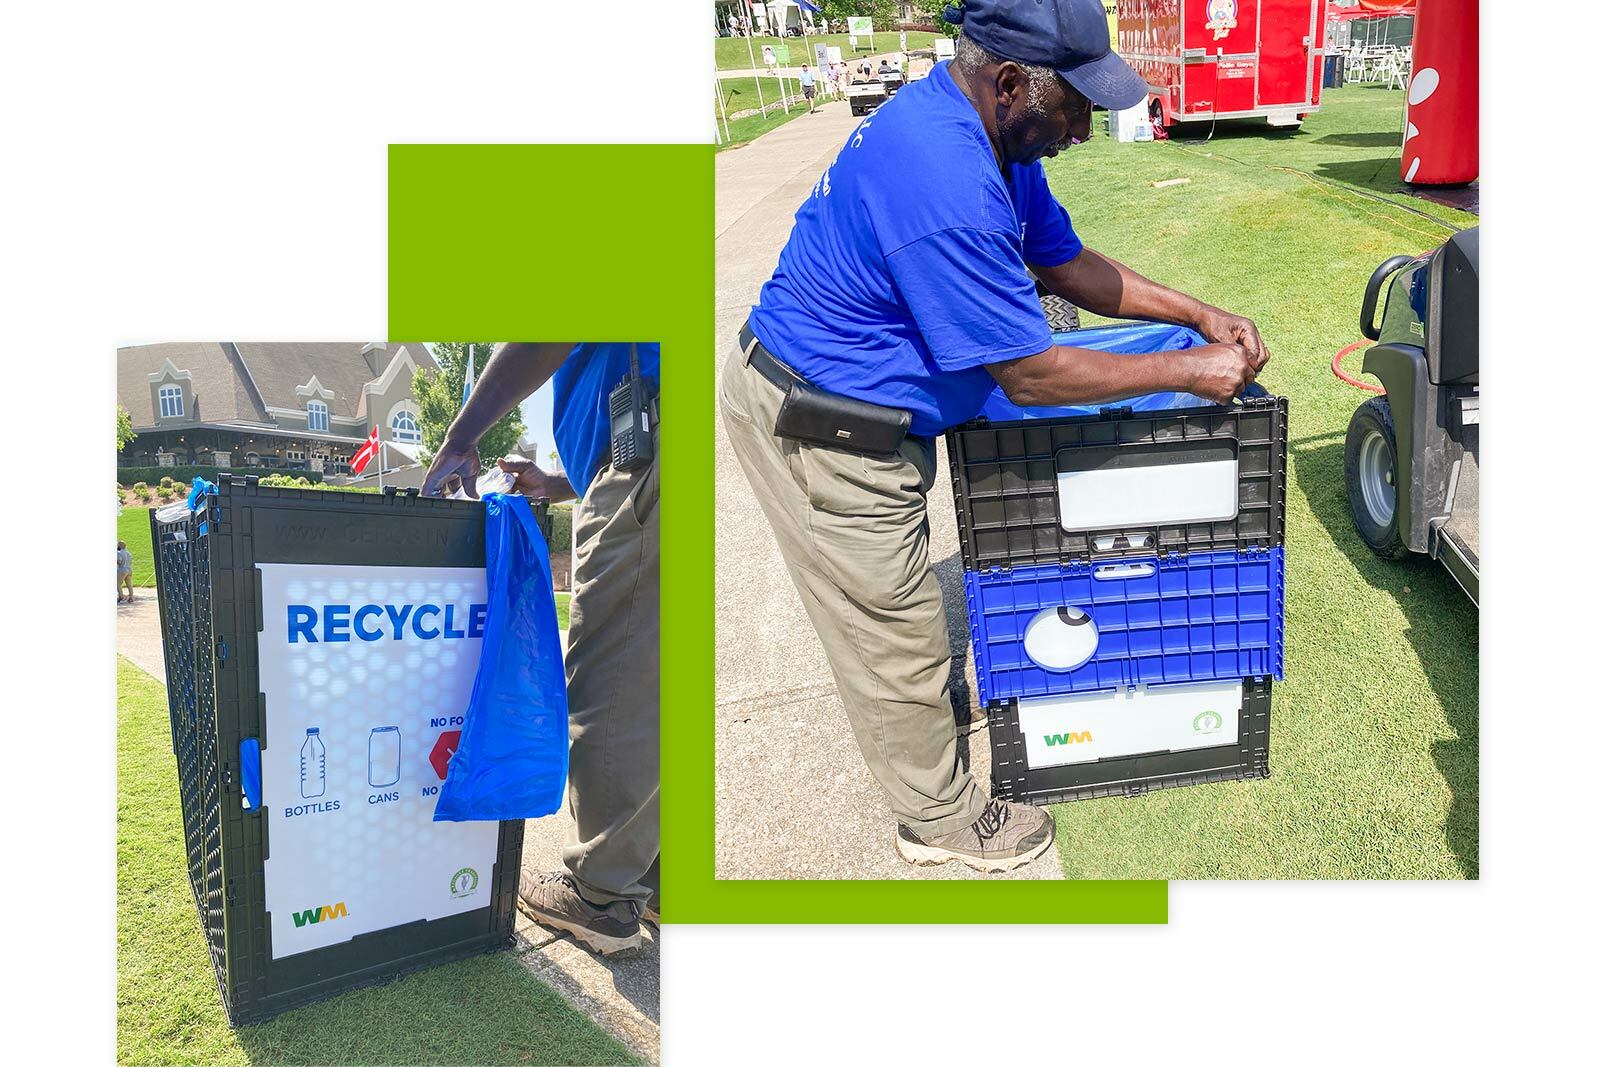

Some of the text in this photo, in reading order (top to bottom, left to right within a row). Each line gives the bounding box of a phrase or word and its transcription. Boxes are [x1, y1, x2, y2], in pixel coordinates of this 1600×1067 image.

[287, 604, 488, 643] RECYCLE
[430, 716, 464, 728] NO FO
[1043, 731, 1093, 747] WM
[368, 791, 399, 805] CANS
[422, 786, 438, 797] NO
[284, 800, 341, 818] BOTTLES
[292, 902, 347, 928] WM
